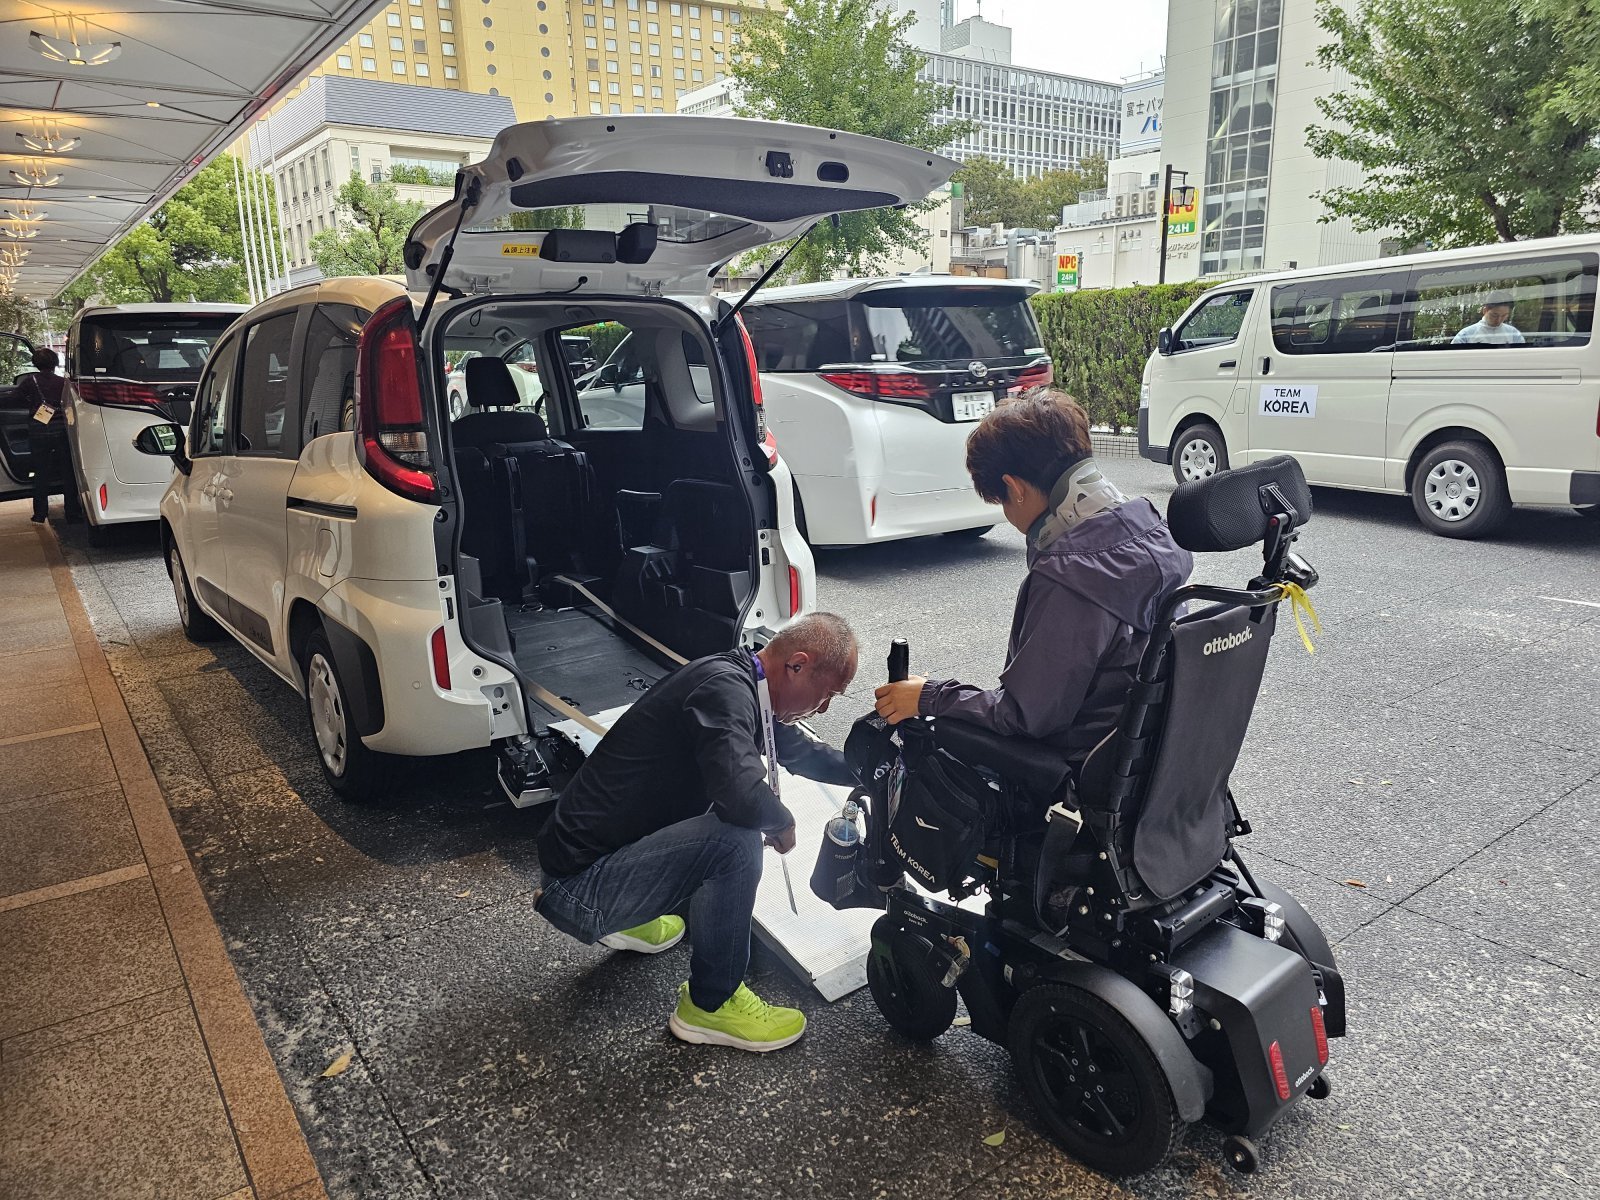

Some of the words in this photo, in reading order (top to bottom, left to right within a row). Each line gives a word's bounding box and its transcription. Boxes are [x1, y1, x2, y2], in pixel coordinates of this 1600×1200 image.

[1168, 223, 1189, 234] 24H
[1059, 255, 1077, 269] NPC
[1274, 388, 1302, 398] TEAM
[1263, 400, 1310, 414] KOREA
[890, 833, 907, 859] TEAM
[907, 856, 936, 883] KOREA
